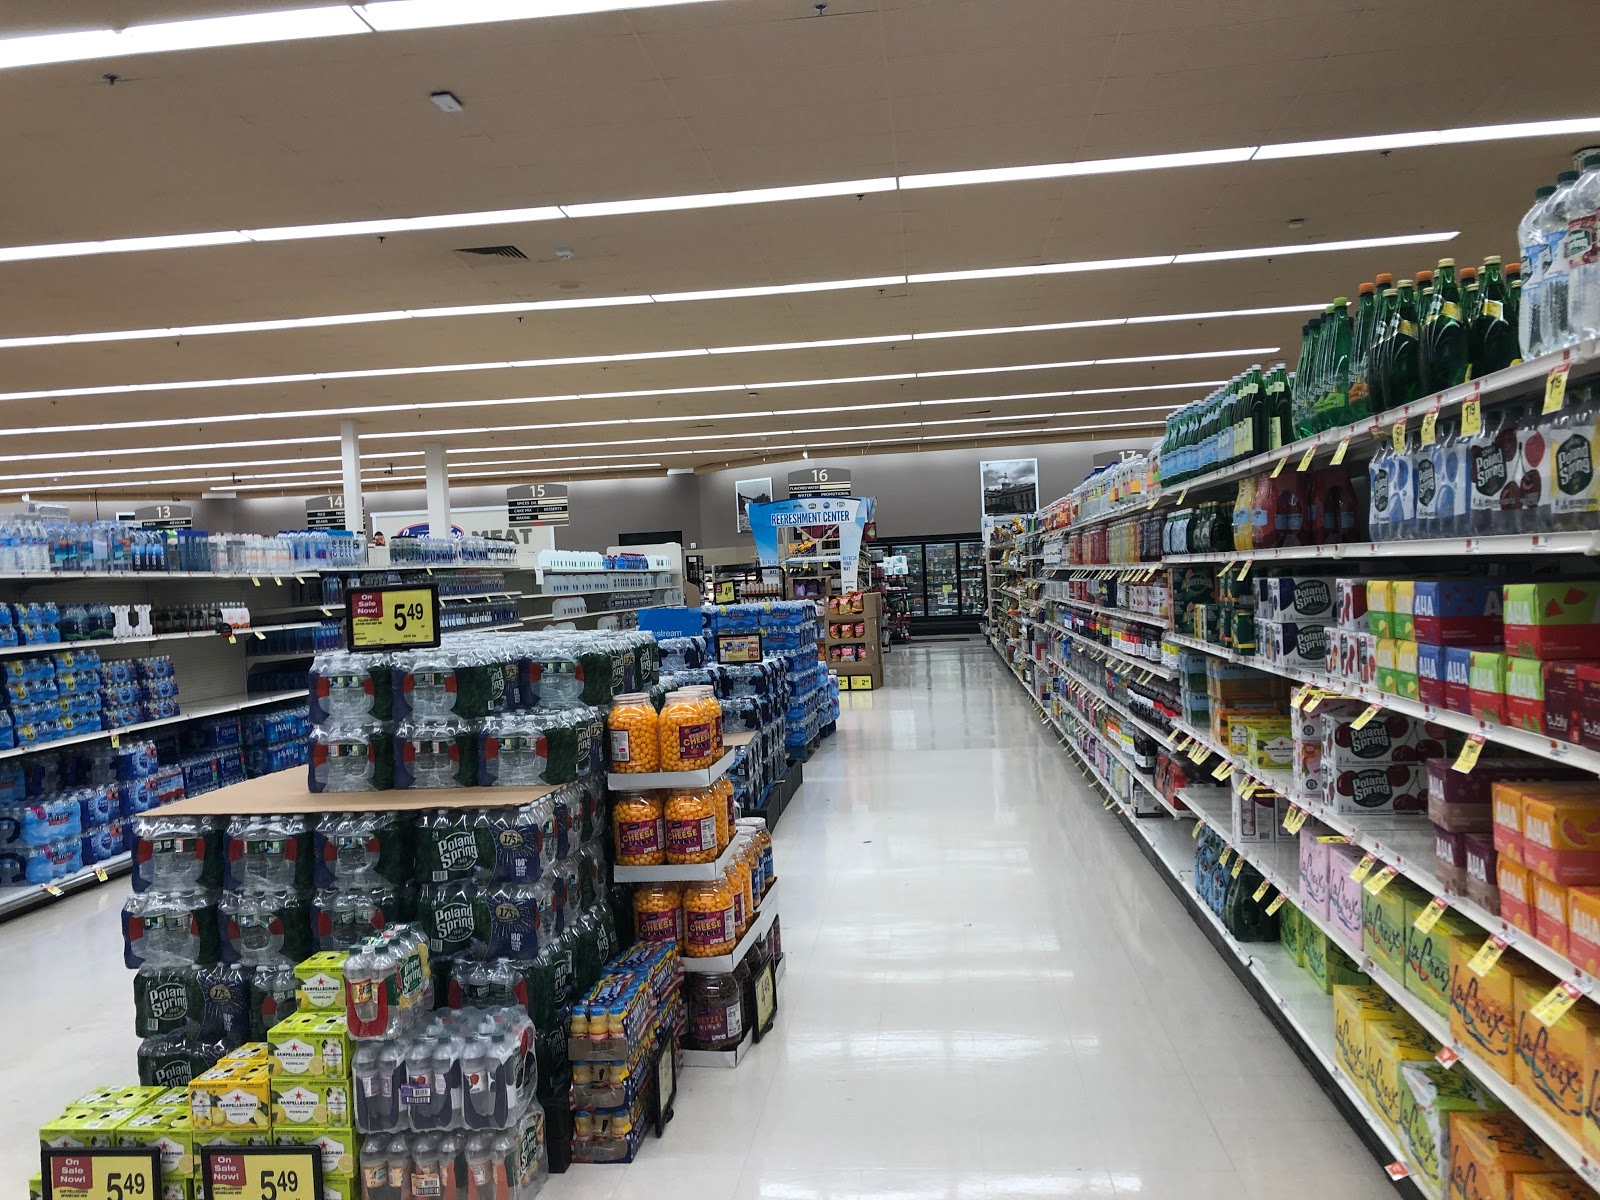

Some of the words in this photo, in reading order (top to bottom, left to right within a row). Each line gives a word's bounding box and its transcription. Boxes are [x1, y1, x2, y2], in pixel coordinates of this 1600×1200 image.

[1119, 450, 1136, 463] 17
[812, 469, 828, 482] 16
[530, 485, 545, 497] 15
[328, 496, 343, 508] 14
[156, 506, 170, 518] 13
[771, 512, 821, 526] REFRESHMENT
[823, 510, 850, 522] CENTER
[1294, 585, 1326, 600] Poland
[1296, 593, 1328, 609] Spring
[1415, 596, 1434, 616] AHA
[1505, 600, 1532, 625] AHA
[1297, 631, 1324, 645] Polan
[1298, 639, 1324, 654] Sprin
[1419, 657, 1438, 680] AHA
[1447, 661, 1469, 685] AHA
[1509, 673, 1538, 700] AHA
[683, 734, 710, 746] CHEESE
[1350, 726, 1386, 742] Poland
[1352, 736, 1388, 752] Spring
[1352, 775, 1388, 789] Poland
[1354, 785, 1389, 800] Spring
[1496, 800, 1519, 830] AHA
[503, 834, 517, 844] 175
[622, 830, 654, 842] CHEESE
[668, 828, 698, 841] CHEESE
[1526, 815, 1552, 848] AHA
[438, 831, 475, 856] Poland
[1436, 836, 1454, 866] AHA
[440, 845, 478, 869] Spring
[1467, 852, 1487, 882] AHA
[1501, 868, 1525, 902] AHA
[1538, 886, 1562, 922] AHA
[435, 902, 473, 925] Poland
[499, 908, 514, 918] 175
[437, 915, 474, 939] Spring
[641, 920, 673, 932] CHEESE
[690, 920, 721, 932] CHEESE
[150, 986, 186, 1004] Poland
[152, 997, 188, 1017] Spring
[155, 1062, 192, 1083] Poland
